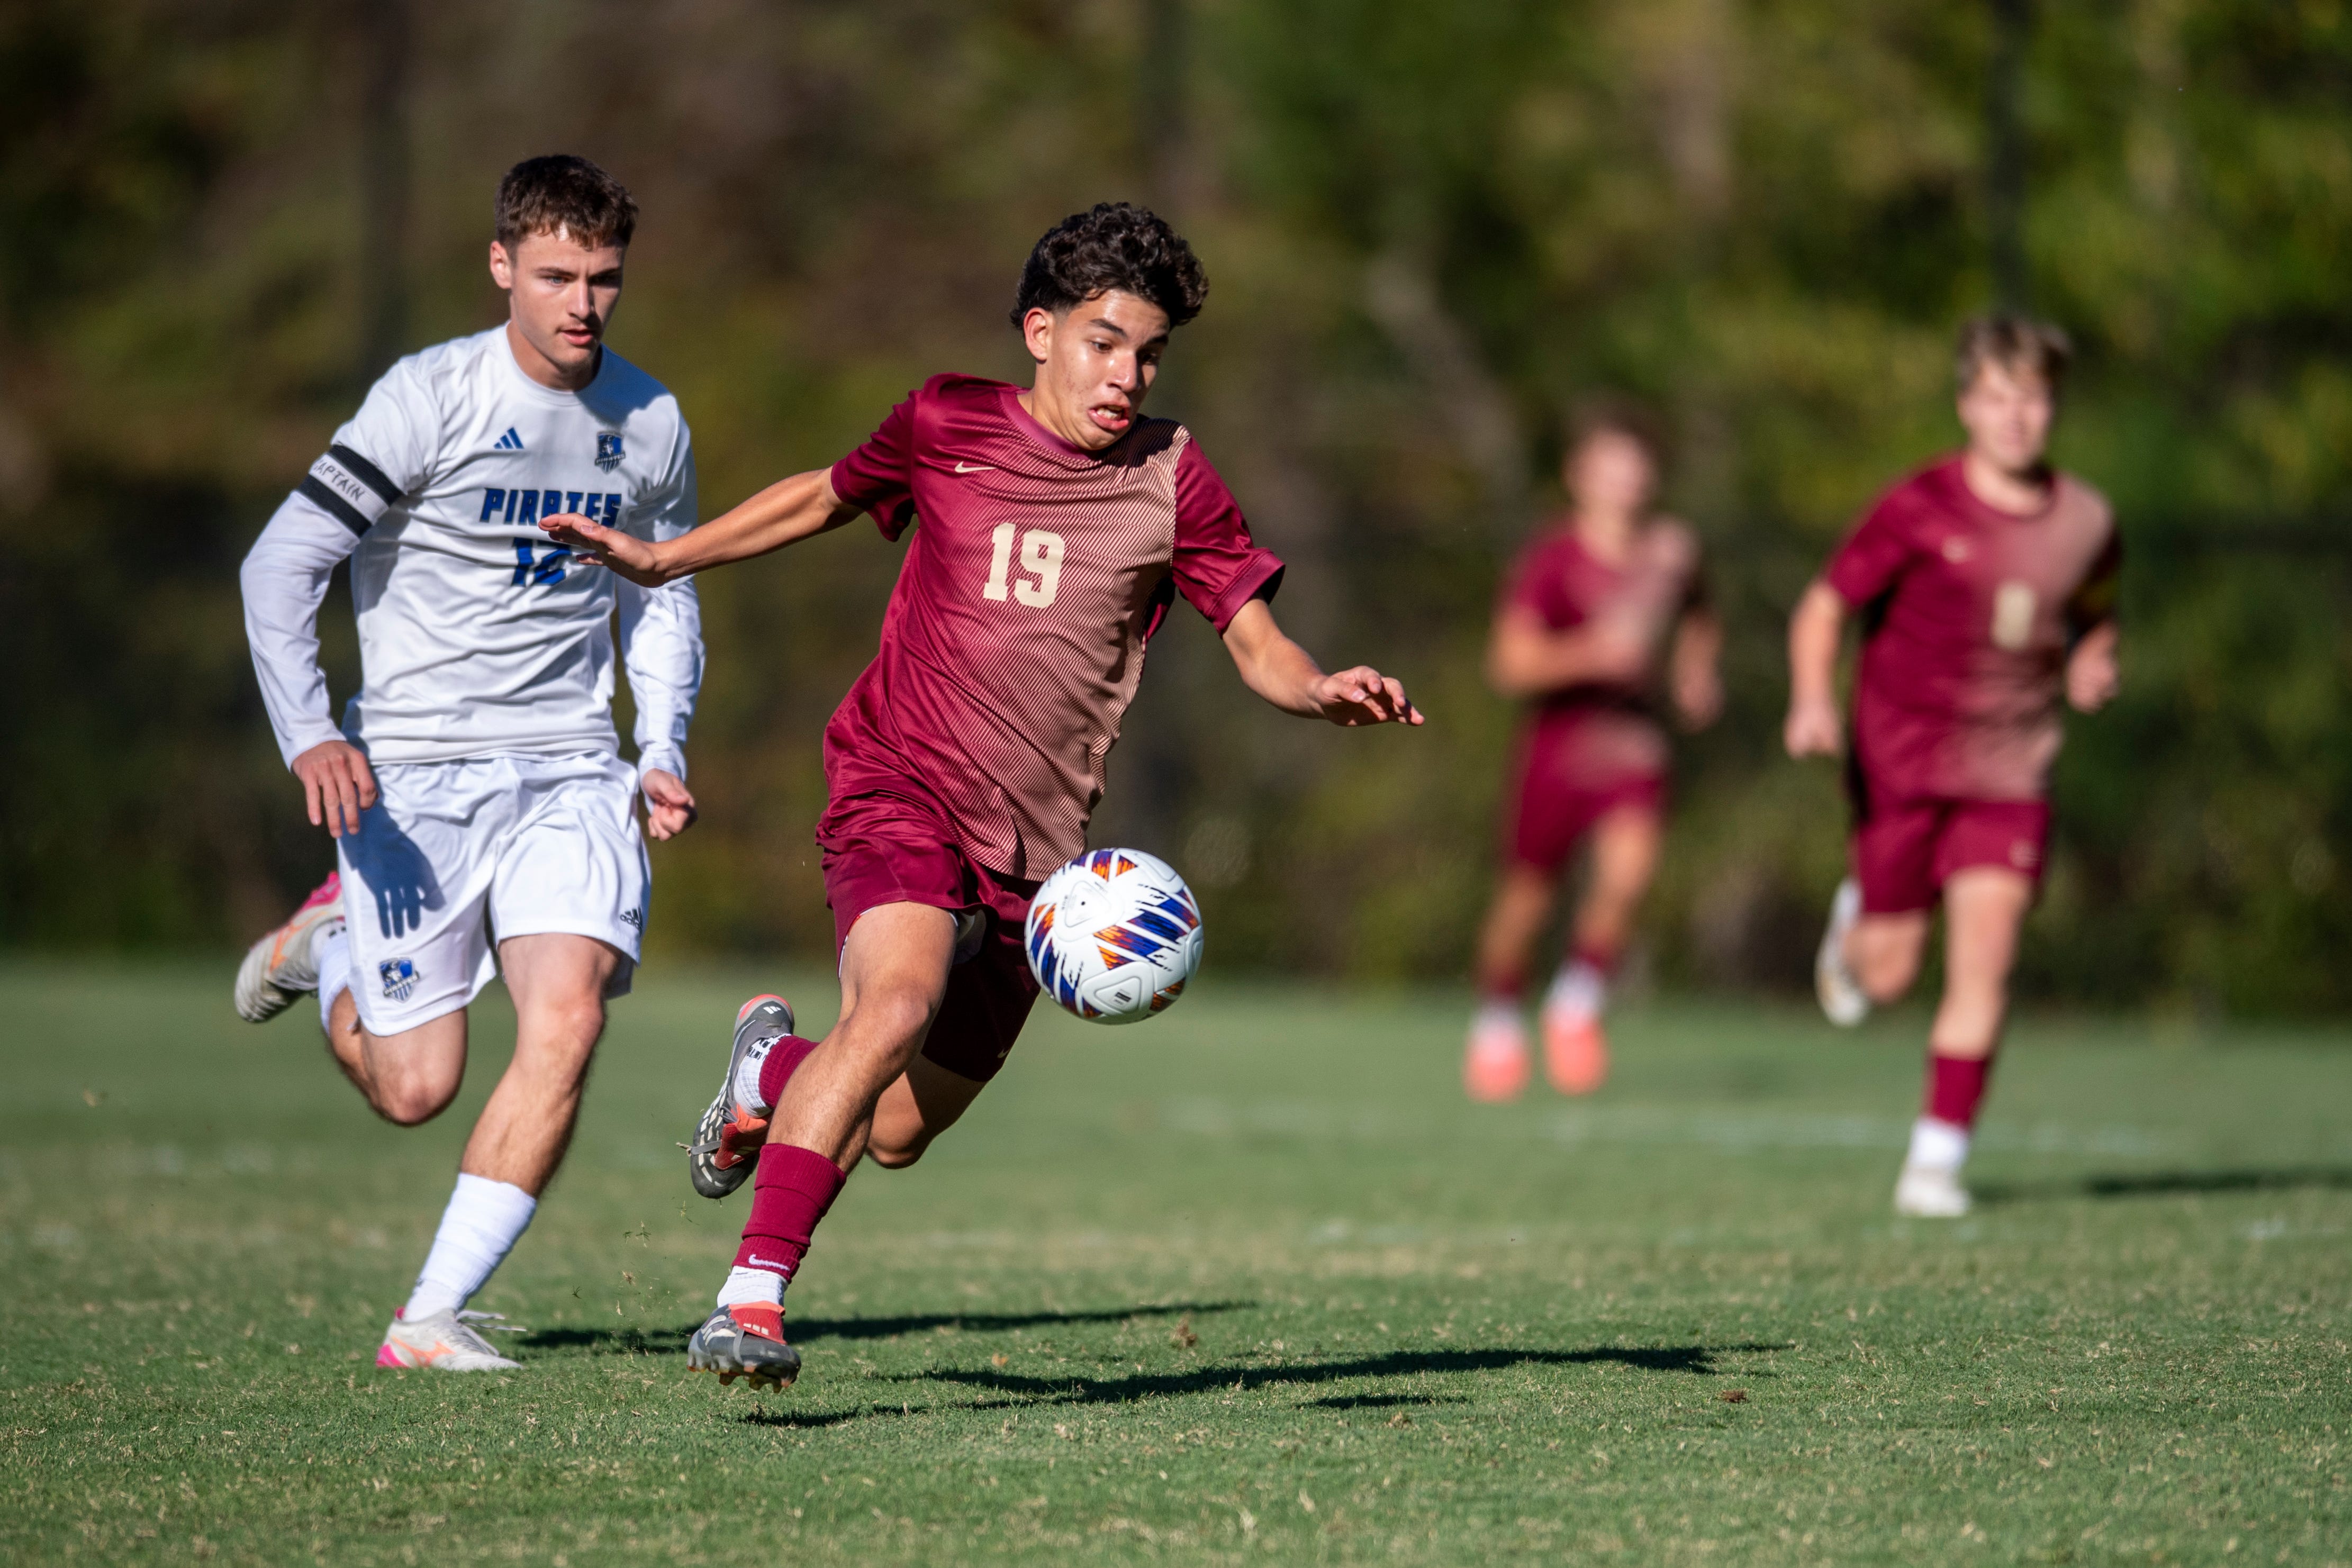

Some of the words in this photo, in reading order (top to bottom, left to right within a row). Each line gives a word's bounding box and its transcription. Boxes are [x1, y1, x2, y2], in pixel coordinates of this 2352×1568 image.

[479, 487, 622, 529] PIRATES
[510, 536, 573, 587] 12
[982, 521, 1066, 609] 19
[619, 914, 643, 935] adid
